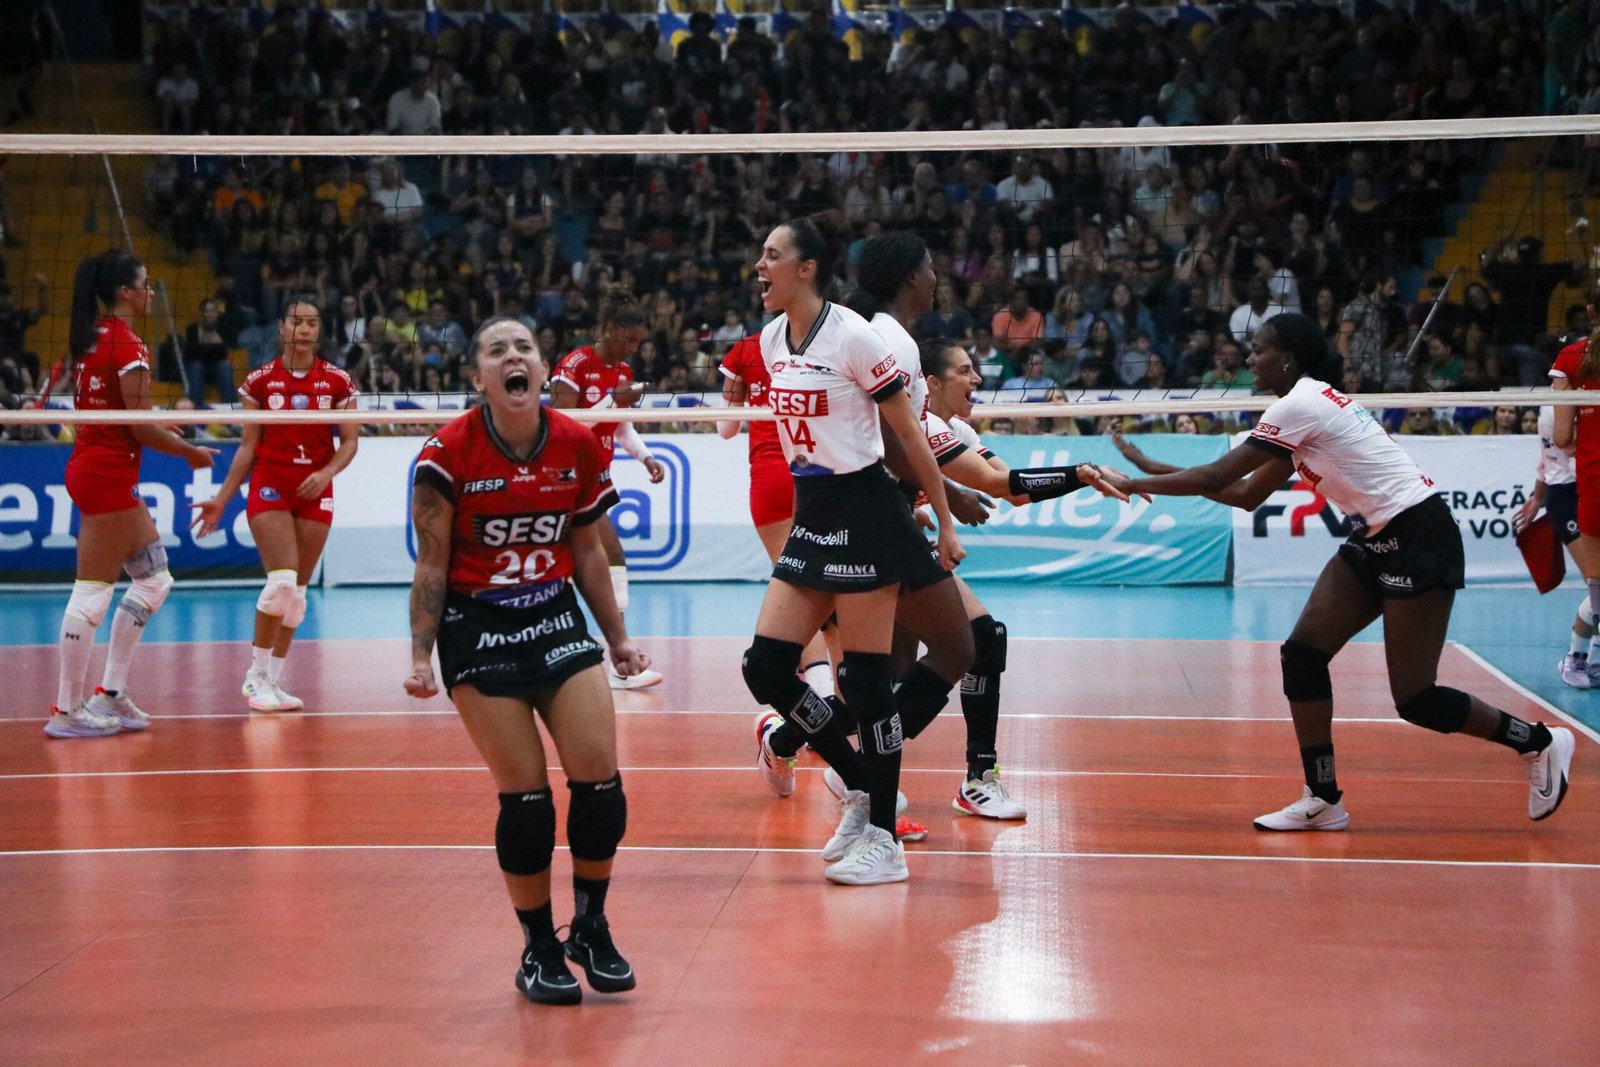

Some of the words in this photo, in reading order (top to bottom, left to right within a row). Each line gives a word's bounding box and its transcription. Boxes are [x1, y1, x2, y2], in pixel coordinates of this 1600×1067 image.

[769, 390, 818, 416] SESI
[780, 417, 817, 454] 14
[463, 478, 505, 494] FIESP
[483, 514, 567, 546] SESI
[489, 549, 556, 585] 20
